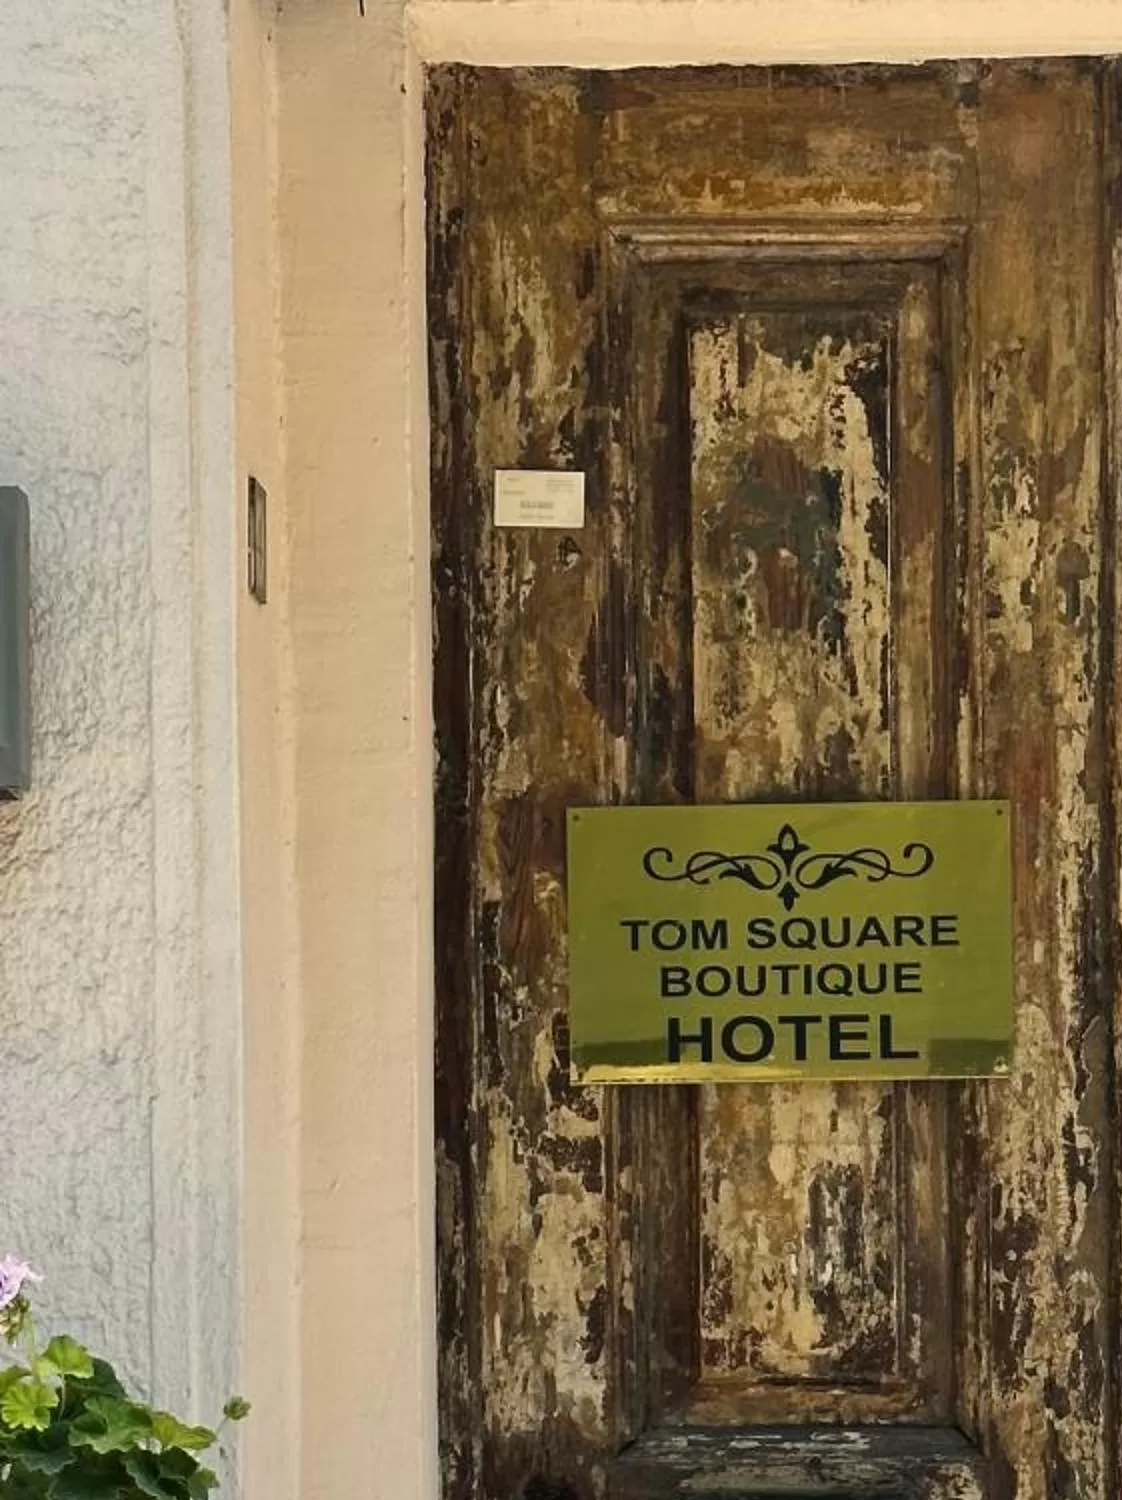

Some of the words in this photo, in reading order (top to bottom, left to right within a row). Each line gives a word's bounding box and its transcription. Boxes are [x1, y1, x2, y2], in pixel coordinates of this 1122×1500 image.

[620, 919, 728, 951] TOM
[747, 914, 960, 950] SQUARE
[660, 962, 922, 997] BOUTIQUE
[667, 1014, 920, 1063] HOTEL
